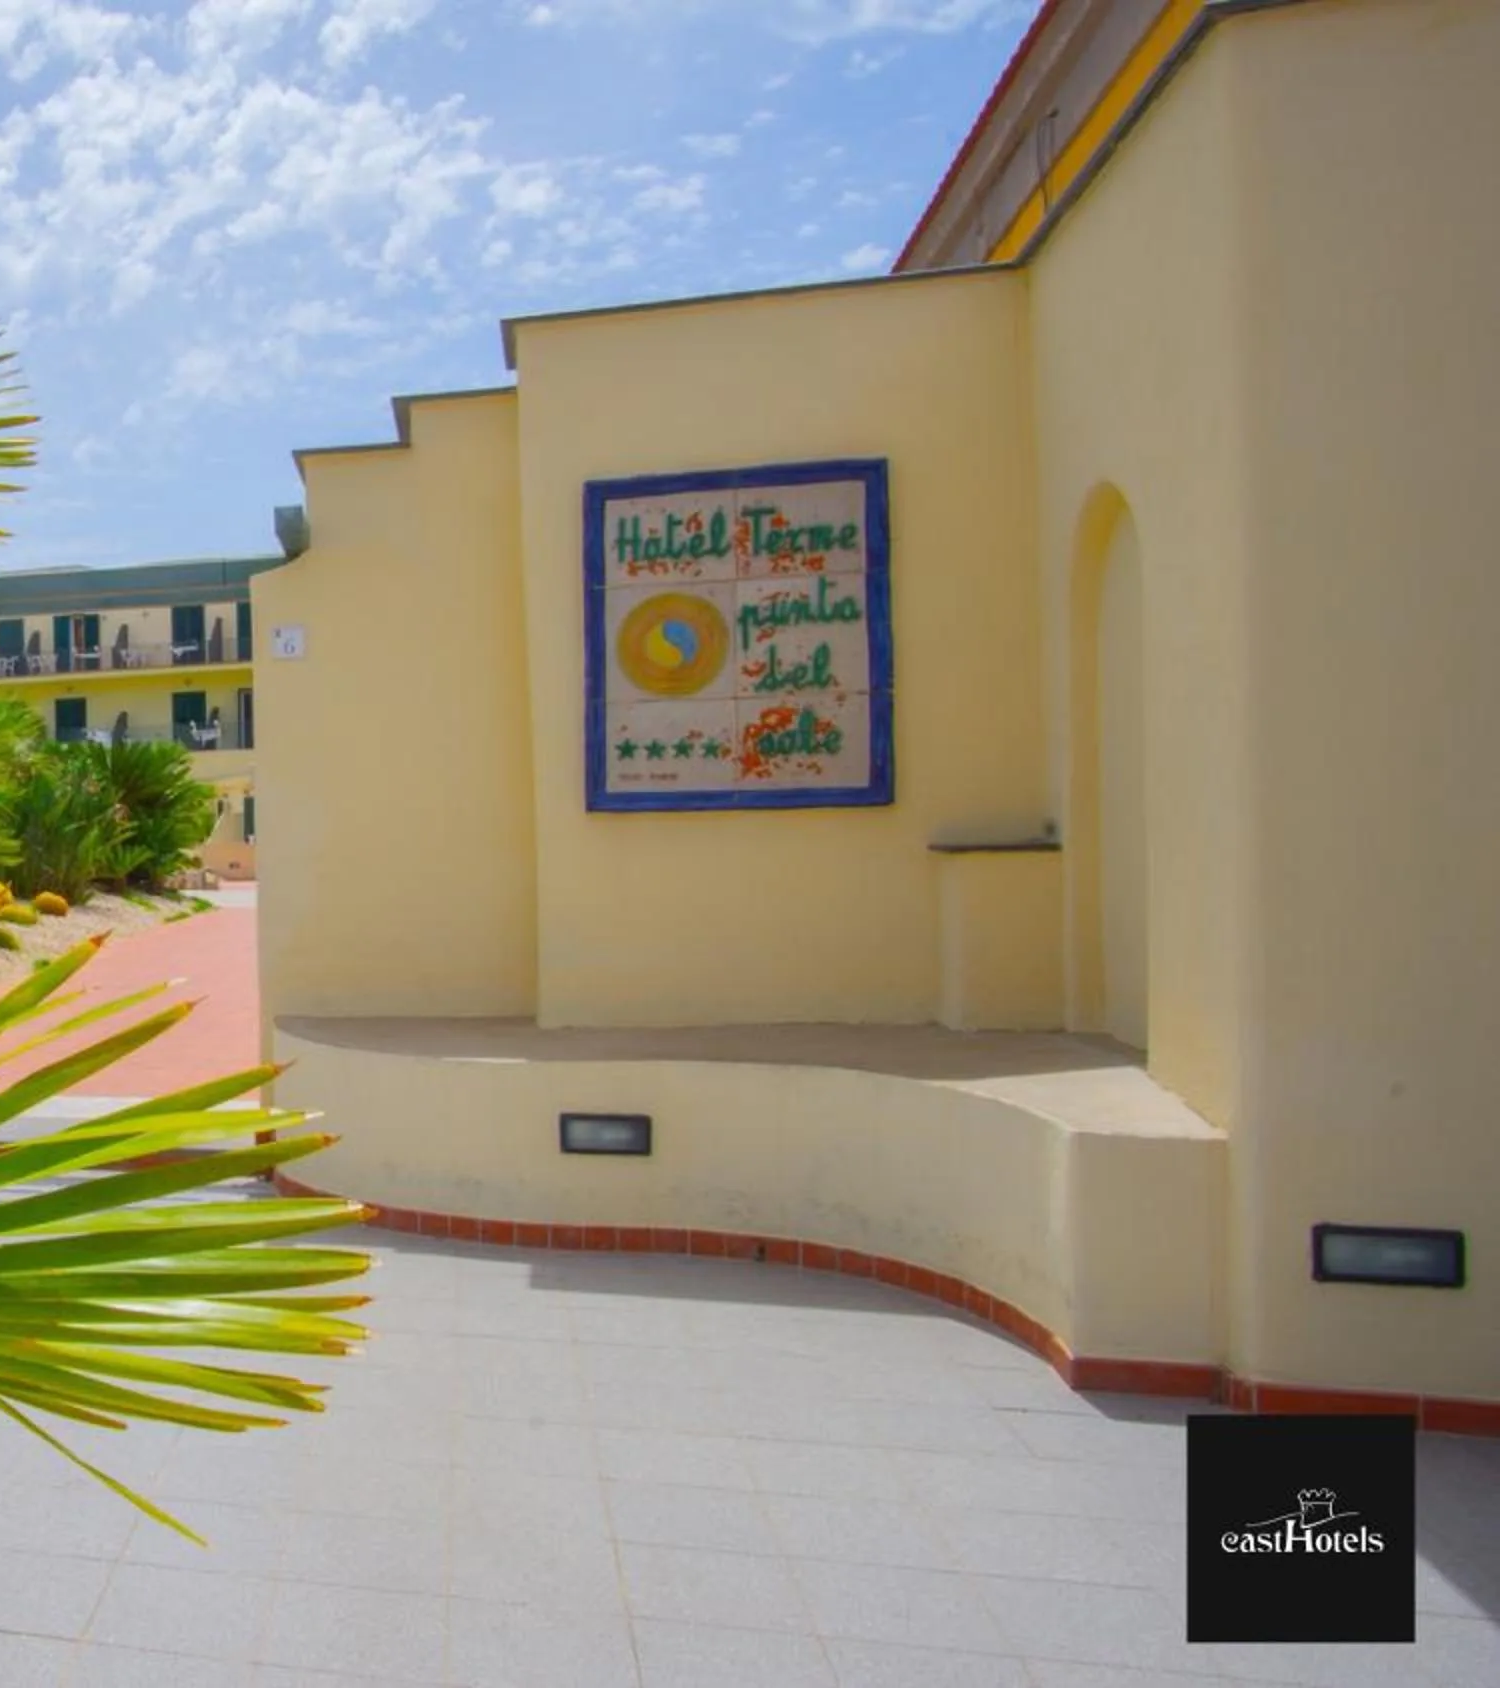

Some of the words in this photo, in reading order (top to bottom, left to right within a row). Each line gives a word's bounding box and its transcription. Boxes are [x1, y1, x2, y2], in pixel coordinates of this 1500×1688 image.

[615, 509, 732, 563] Hotel
[741, 505, 858, 557] Terme
[753, 643, 833, 692] del
